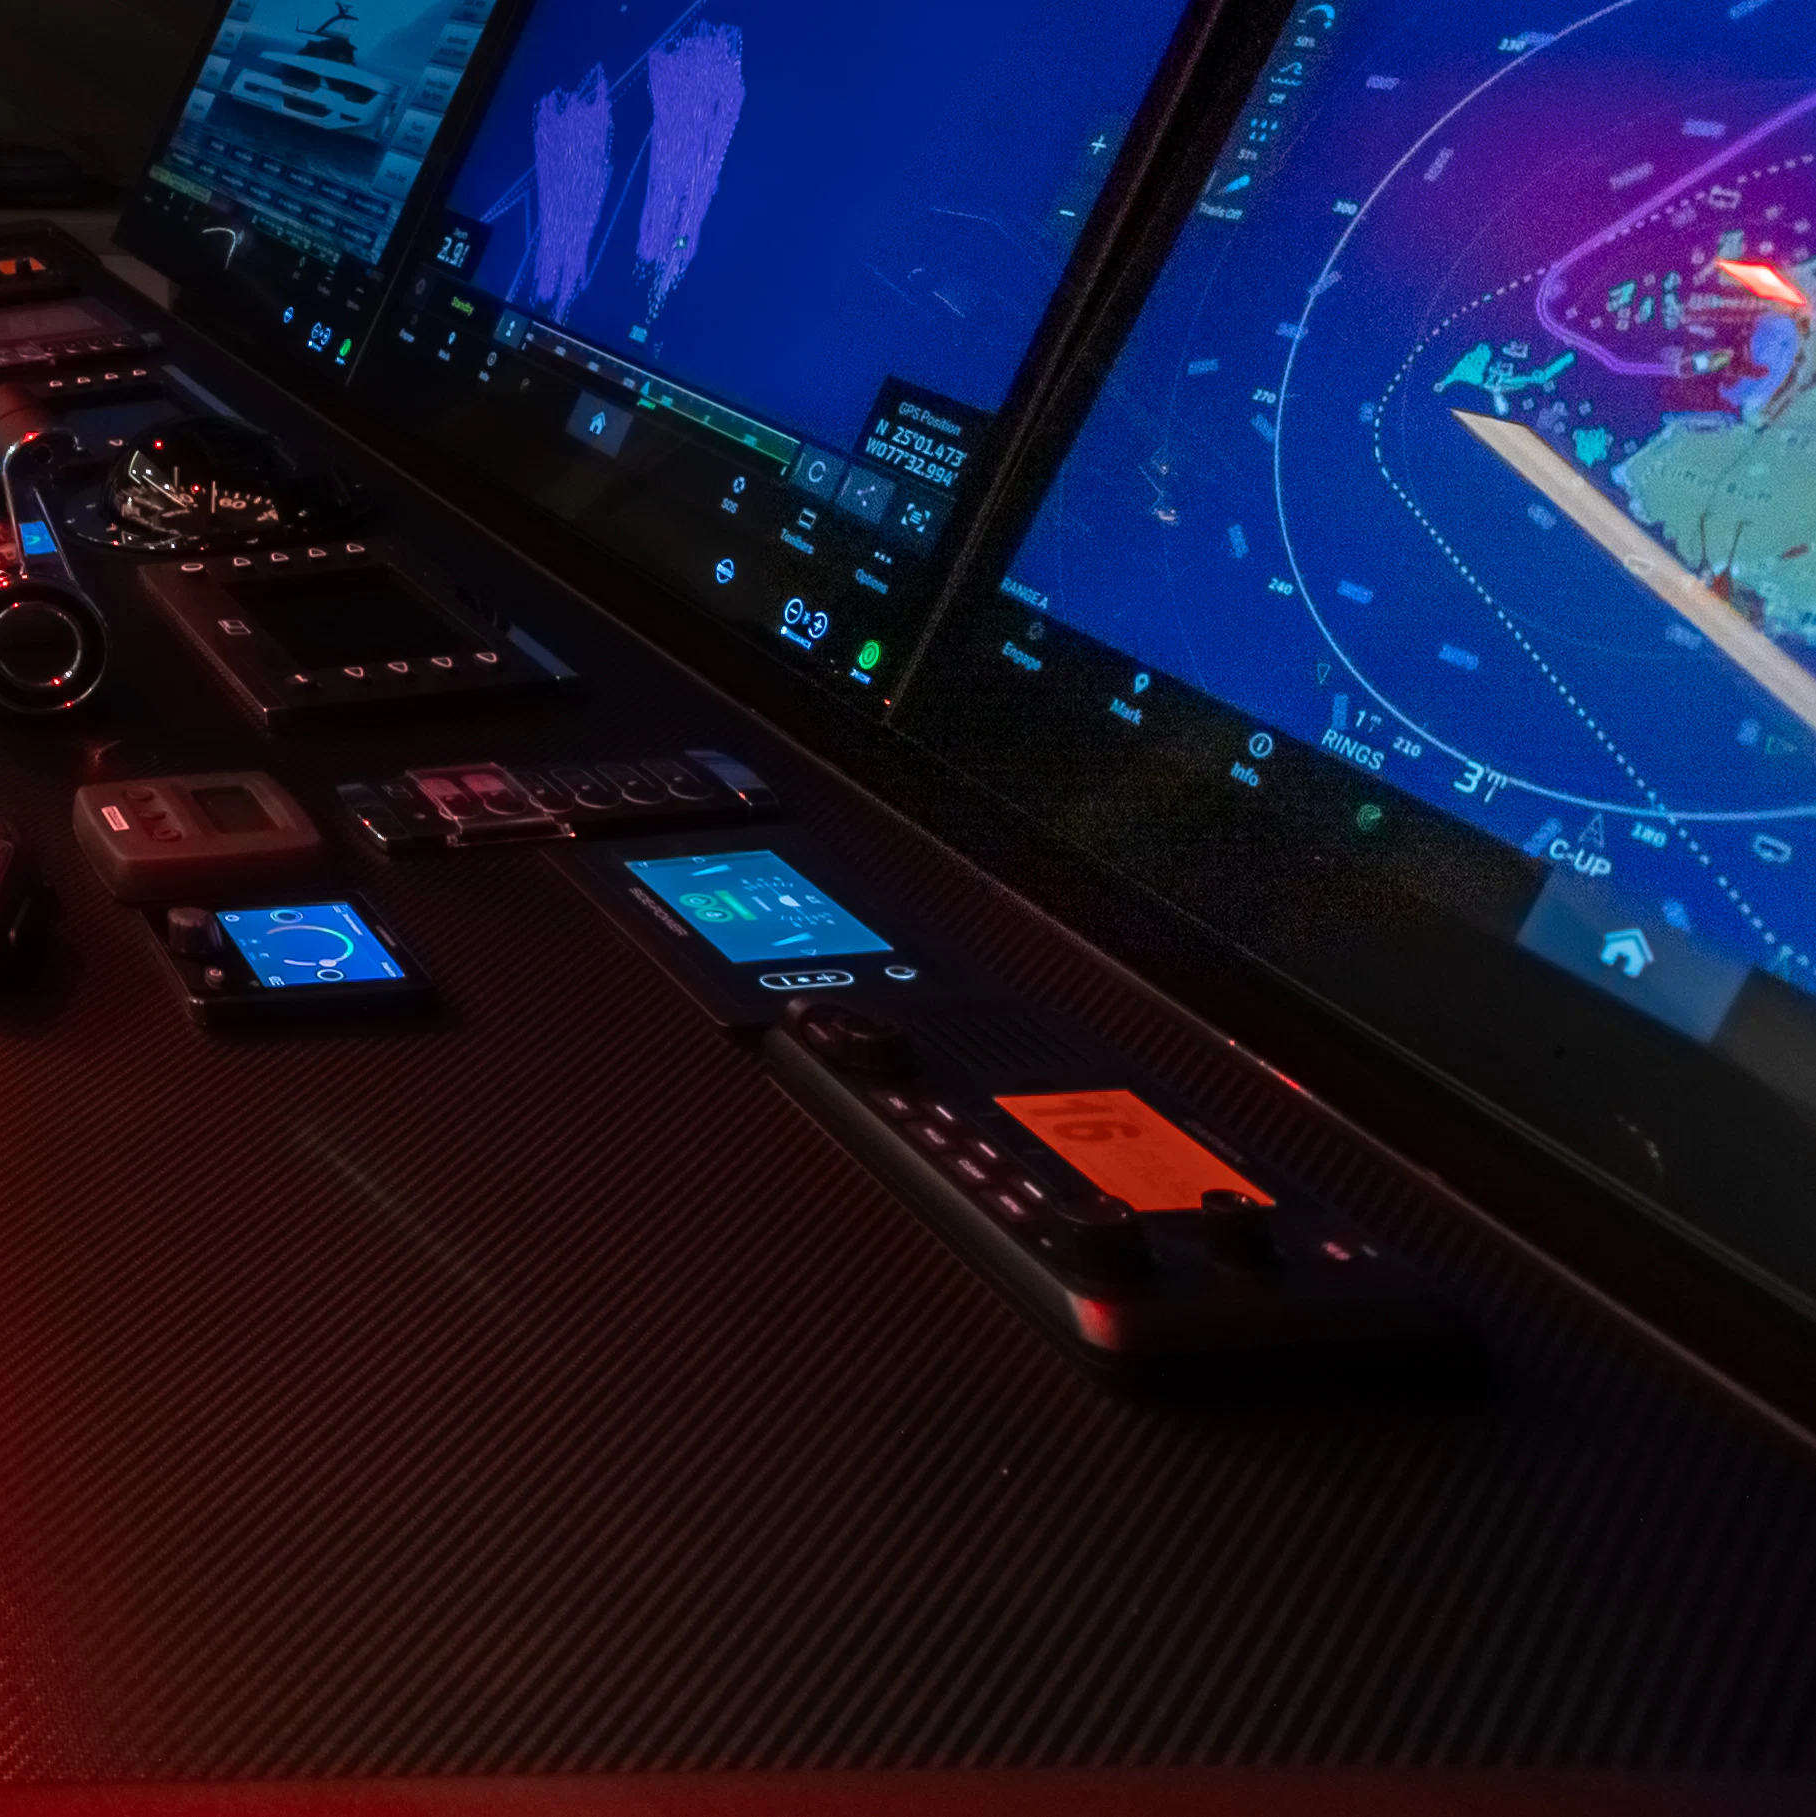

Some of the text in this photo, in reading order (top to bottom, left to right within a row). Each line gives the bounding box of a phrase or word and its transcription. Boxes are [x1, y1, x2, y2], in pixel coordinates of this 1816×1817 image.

[898, 401, 921, 421] GPS
[875, 418, 889, 436] N
[720, 497, 739, 514] SOS
[1110, 698, 1143, 726] Mark
[1321, 728, 1385, 771] RINGS
[1230, 761, 1260, 787] Info
[1548, 837, 1613, 877] C-UP
